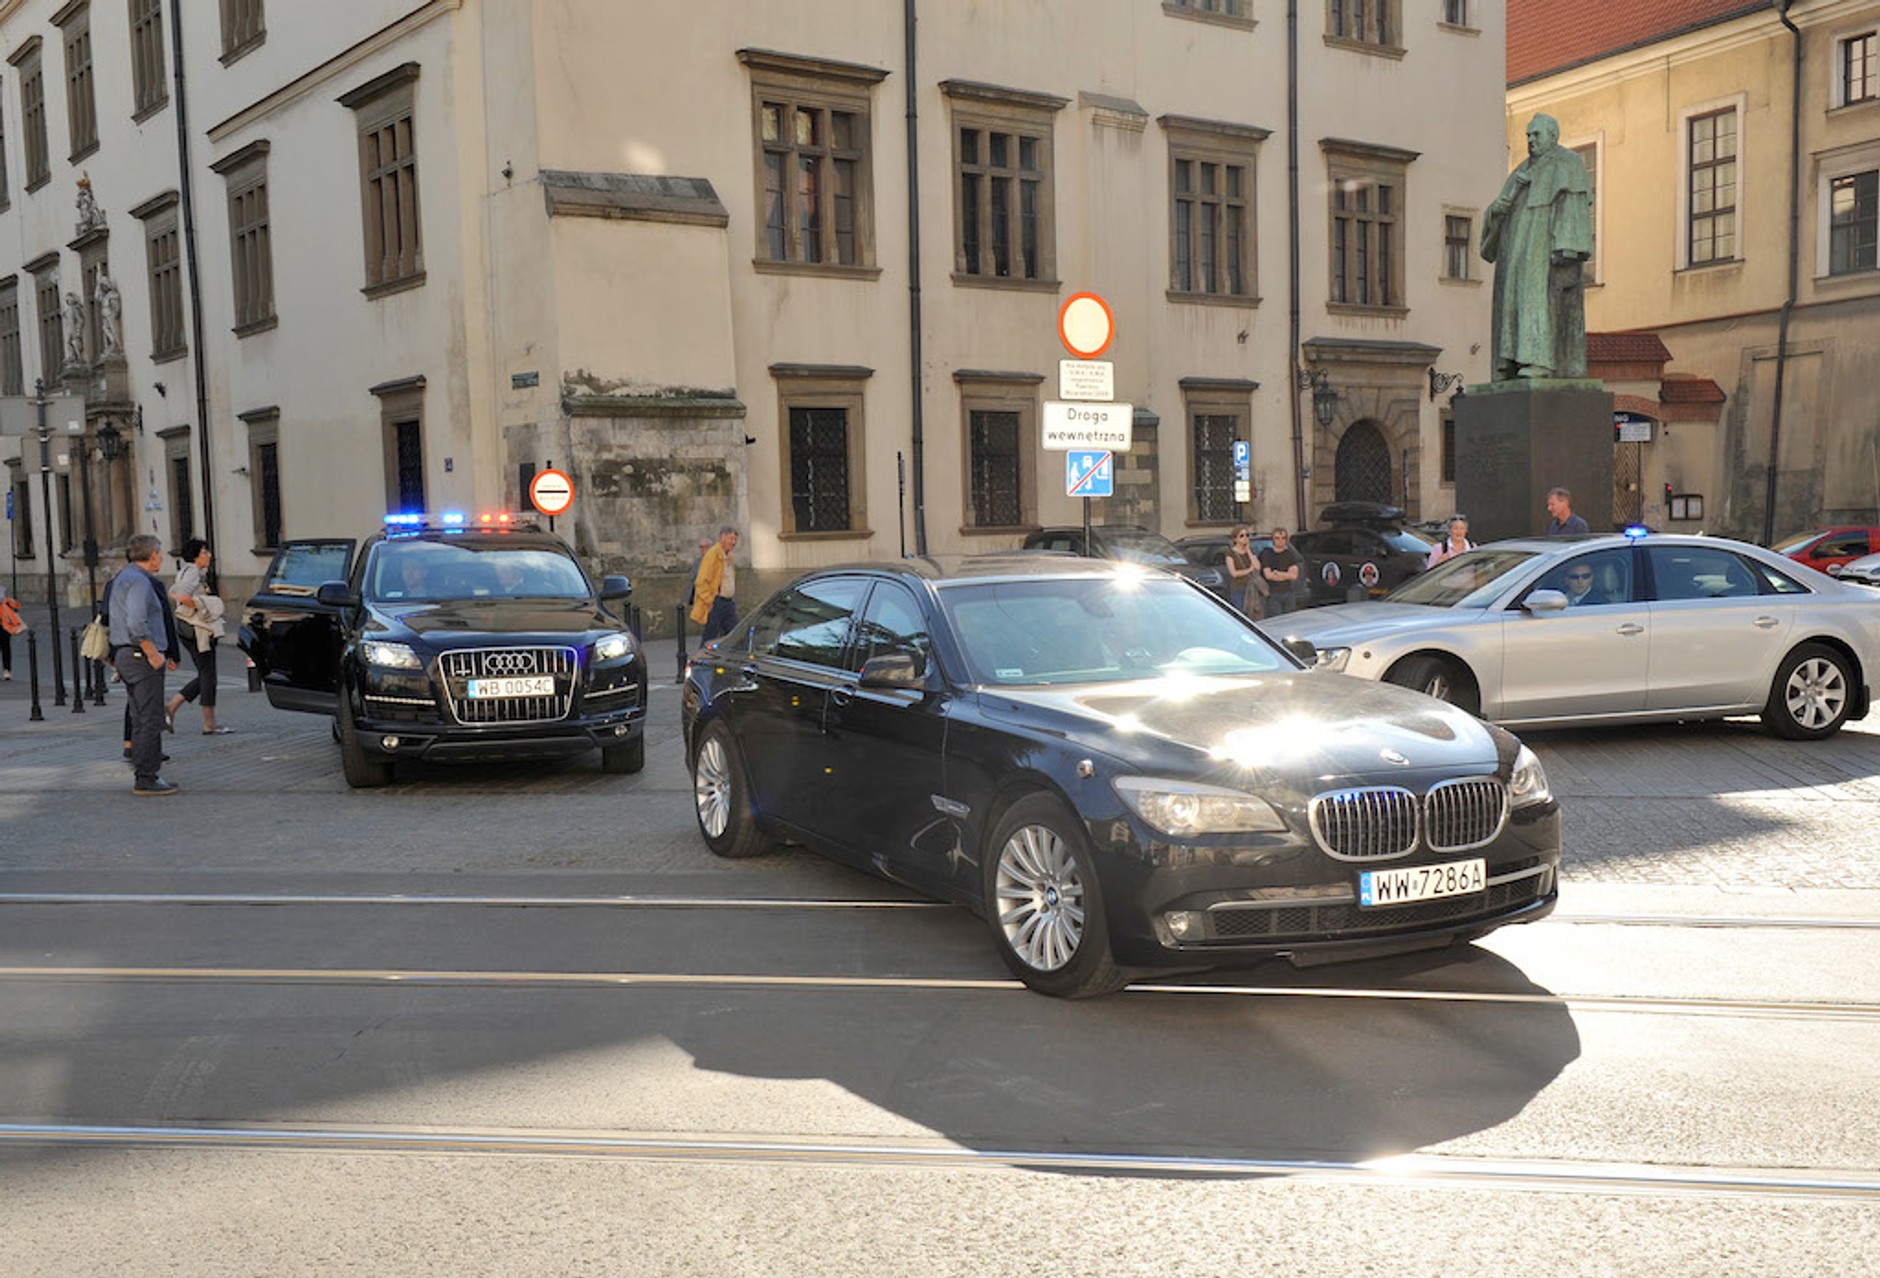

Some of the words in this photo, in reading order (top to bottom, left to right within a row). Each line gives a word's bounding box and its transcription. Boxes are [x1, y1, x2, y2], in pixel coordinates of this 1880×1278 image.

[1067, 407, 1109, 425] Droga
[1237, 444, 1246, 461] P
[477, 681, 501, 696] WB
[1376, 872, 1410, 901] WW
[1419, 863, 1483, 896] 7286A
